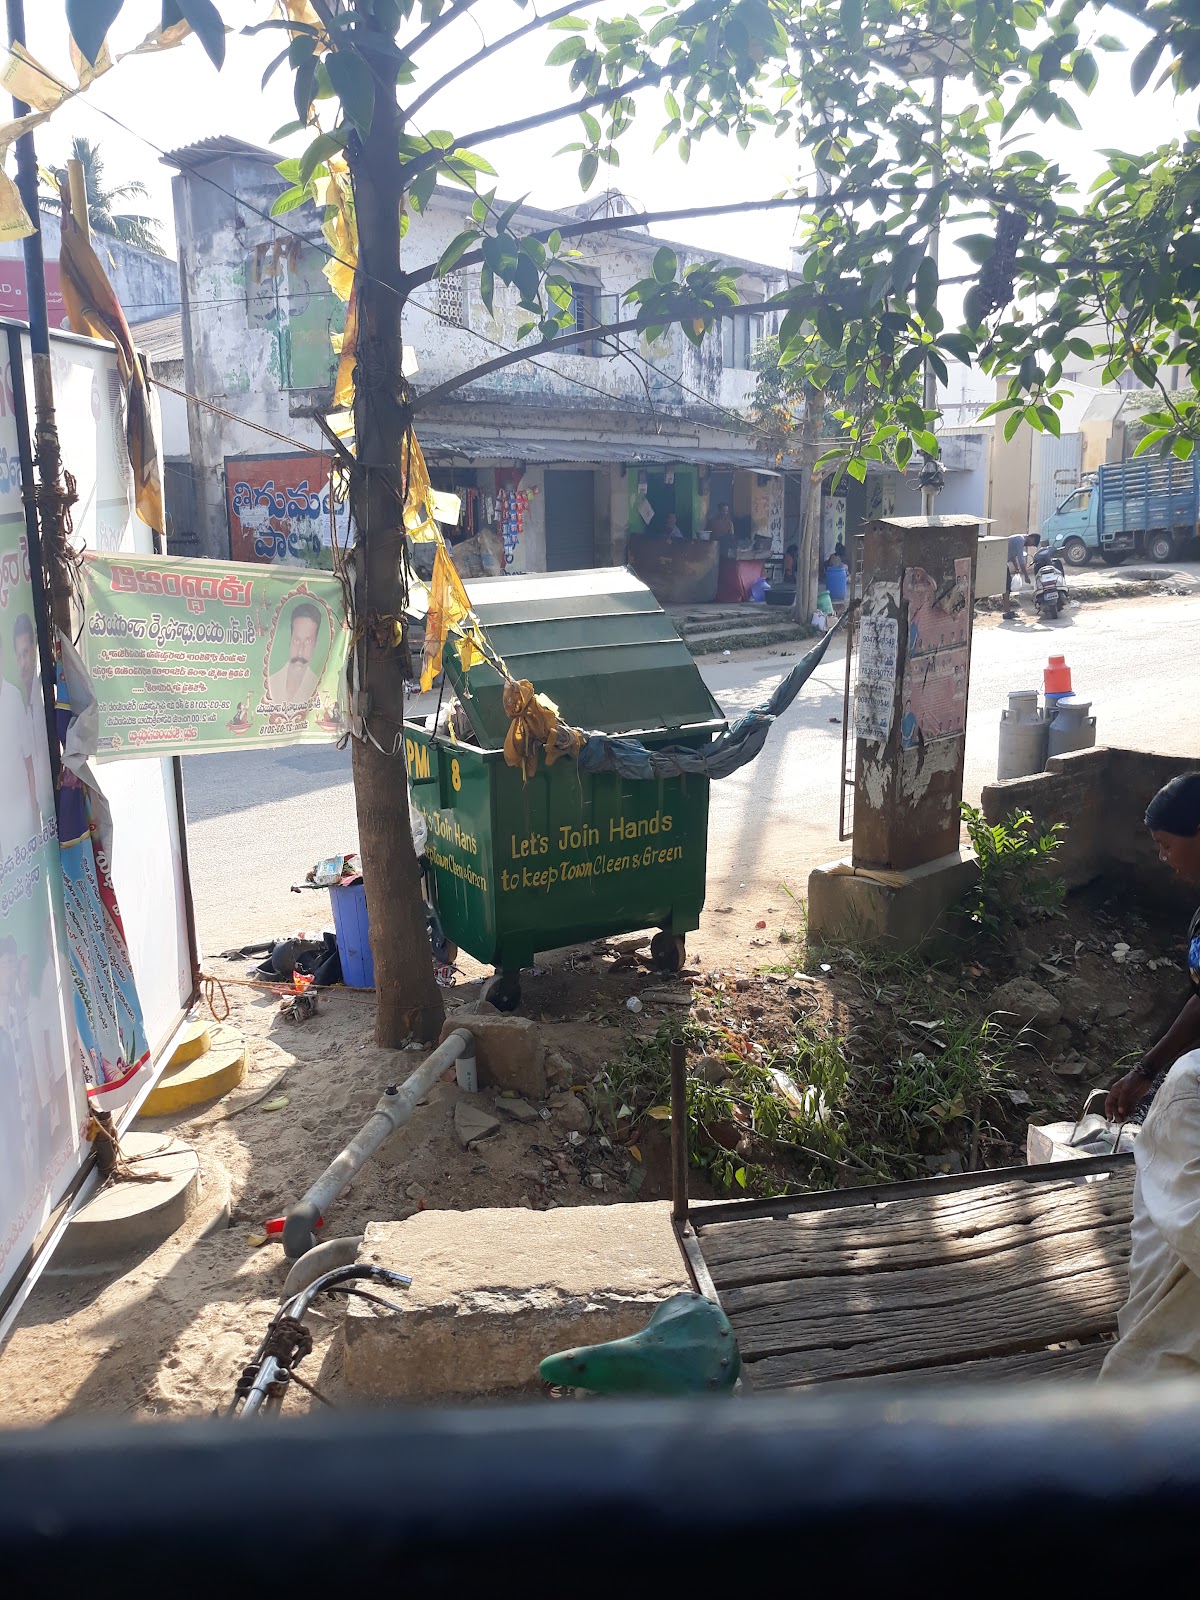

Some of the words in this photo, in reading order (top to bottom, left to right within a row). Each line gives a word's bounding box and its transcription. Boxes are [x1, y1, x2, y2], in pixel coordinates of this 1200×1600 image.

[451, 758, 461, 792] 8
[433, 810, 453, 845] Join
[511, 832, 549, 860] Let's
[559, 824, 600, 850] Join
[609, 810, 673, 842] Hands
[501, 869, 519, 892] to
[522, 866, 560, 893] keep
[559, 860, 593, 881] Town
[641, 844, 683, 868] Green
